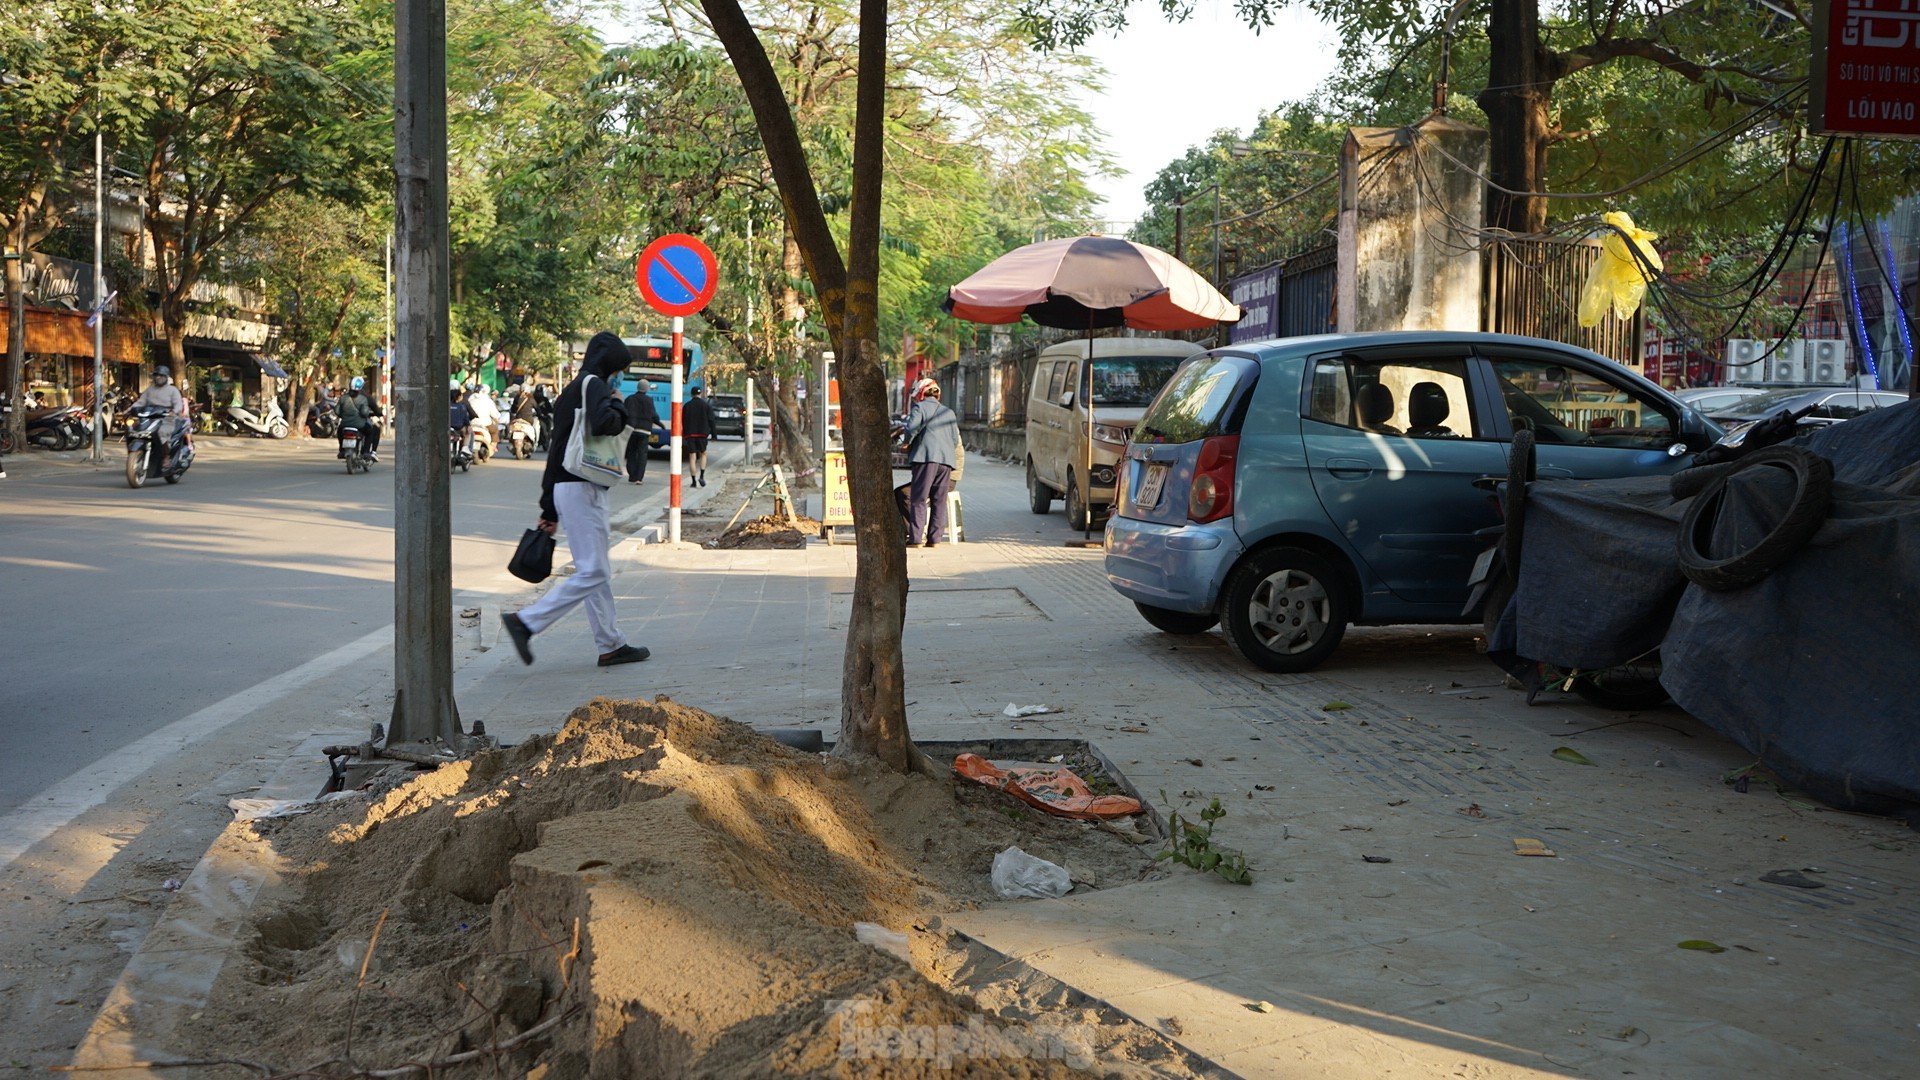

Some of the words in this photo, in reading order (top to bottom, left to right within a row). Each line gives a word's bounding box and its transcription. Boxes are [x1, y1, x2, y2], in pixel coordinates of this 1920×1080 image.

[1856, 64, 1874, 81] 101
[1848, 93, 1876, 118] LỐI
[1881, 98, 1915, 121] VÀO
